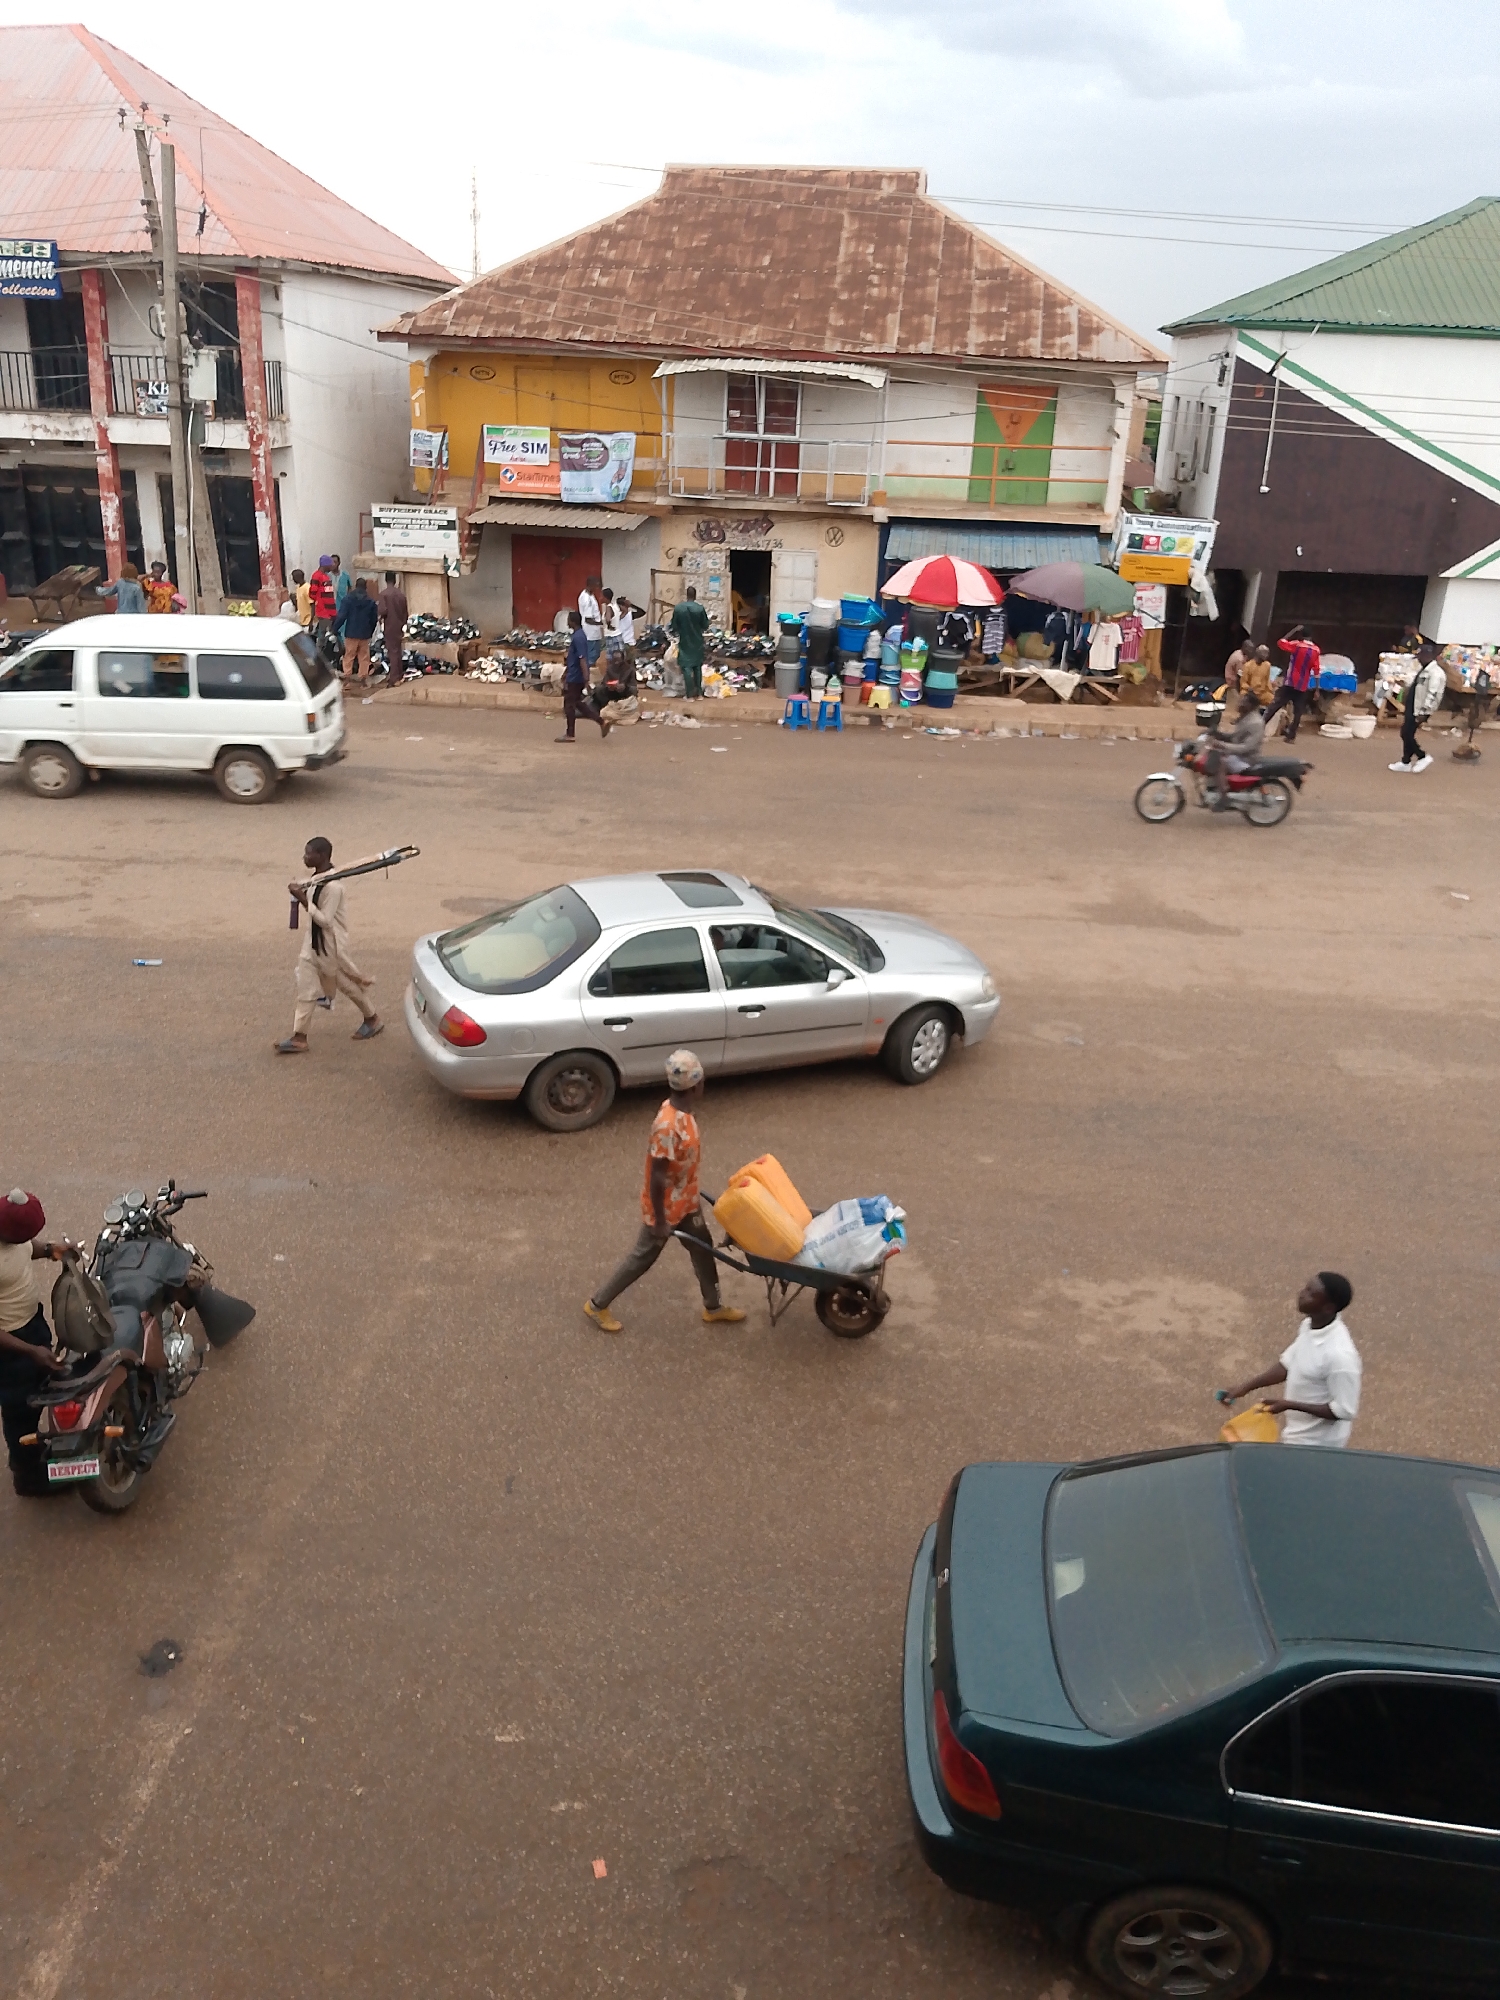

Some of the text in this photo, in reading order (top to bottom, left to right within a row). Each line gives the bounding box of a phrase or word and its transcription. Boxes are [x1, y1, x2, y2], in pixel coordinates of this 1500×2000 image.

[0, 283, 57, 296] ollection
[488, 439, 548, 455] Free SIM
[516, 471, 561, 483] StarTimes
[50, 1463, 97, 1477] RESPECT
